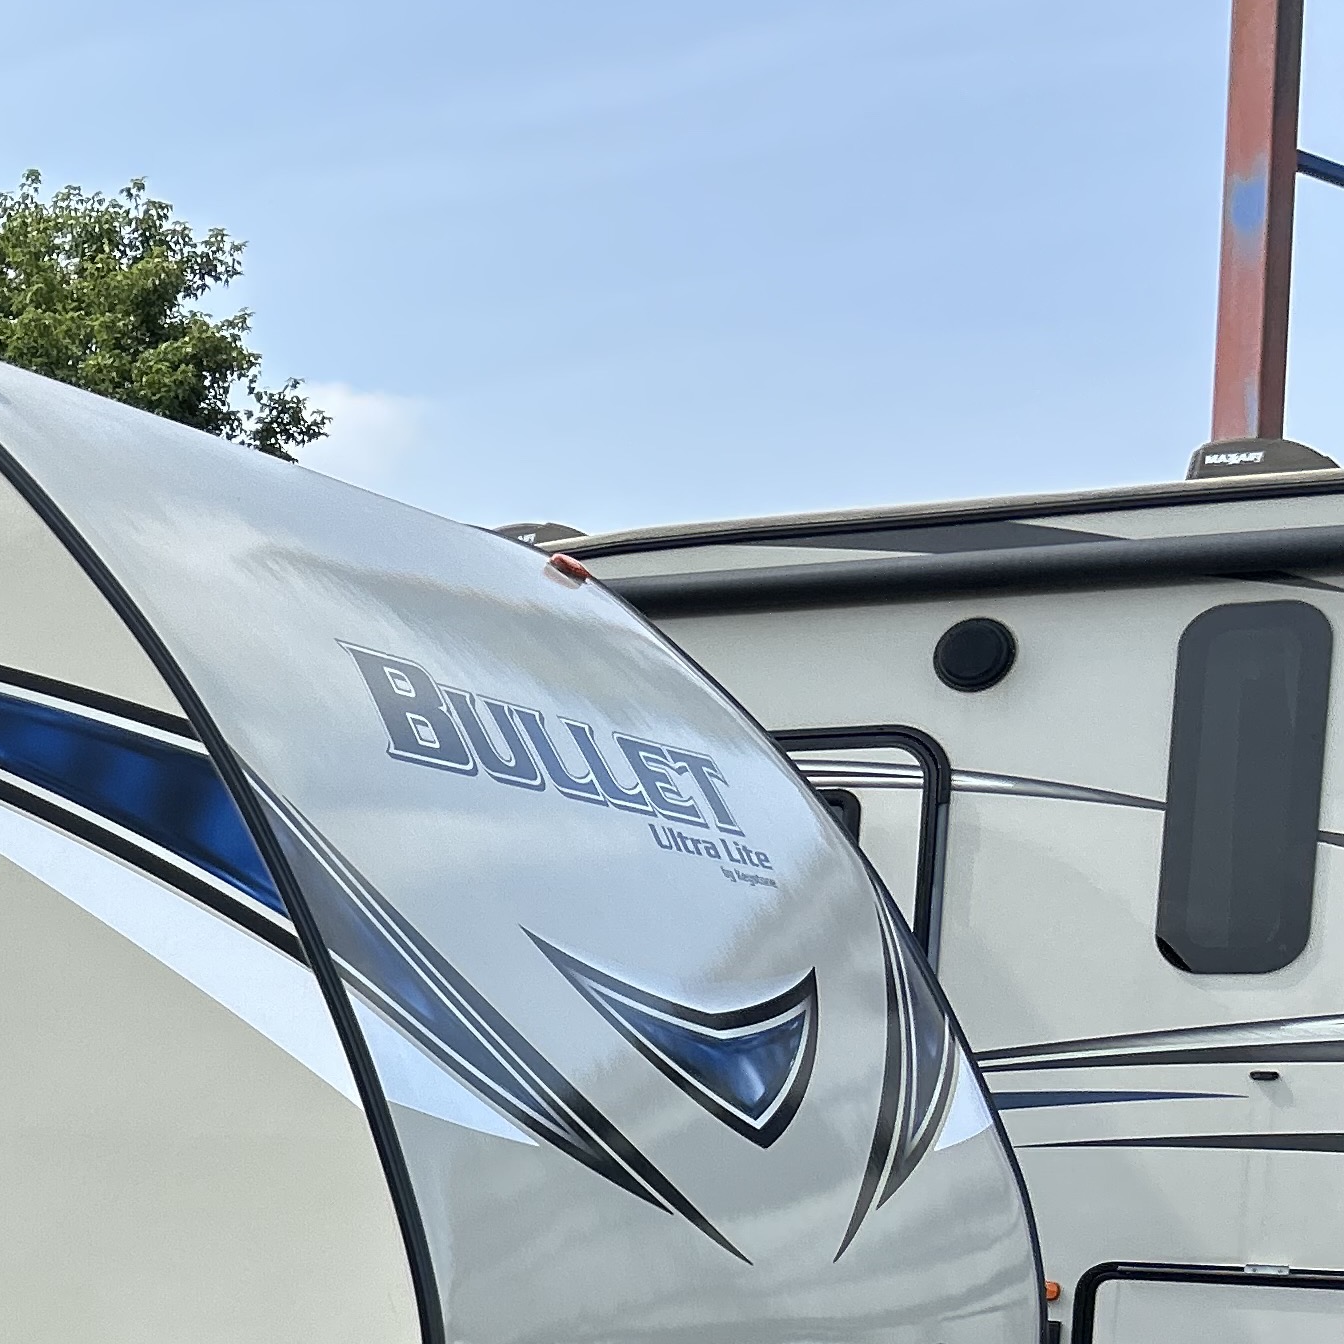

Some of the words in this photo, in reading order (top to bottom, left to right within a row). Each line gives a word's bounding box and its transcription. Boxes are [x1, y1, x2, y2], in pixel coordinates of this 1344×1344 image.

[335, 638, 745, 836] BULLET
[648, 823, 721, 860] Ultra
[720, 837, 773, 870] Lite
